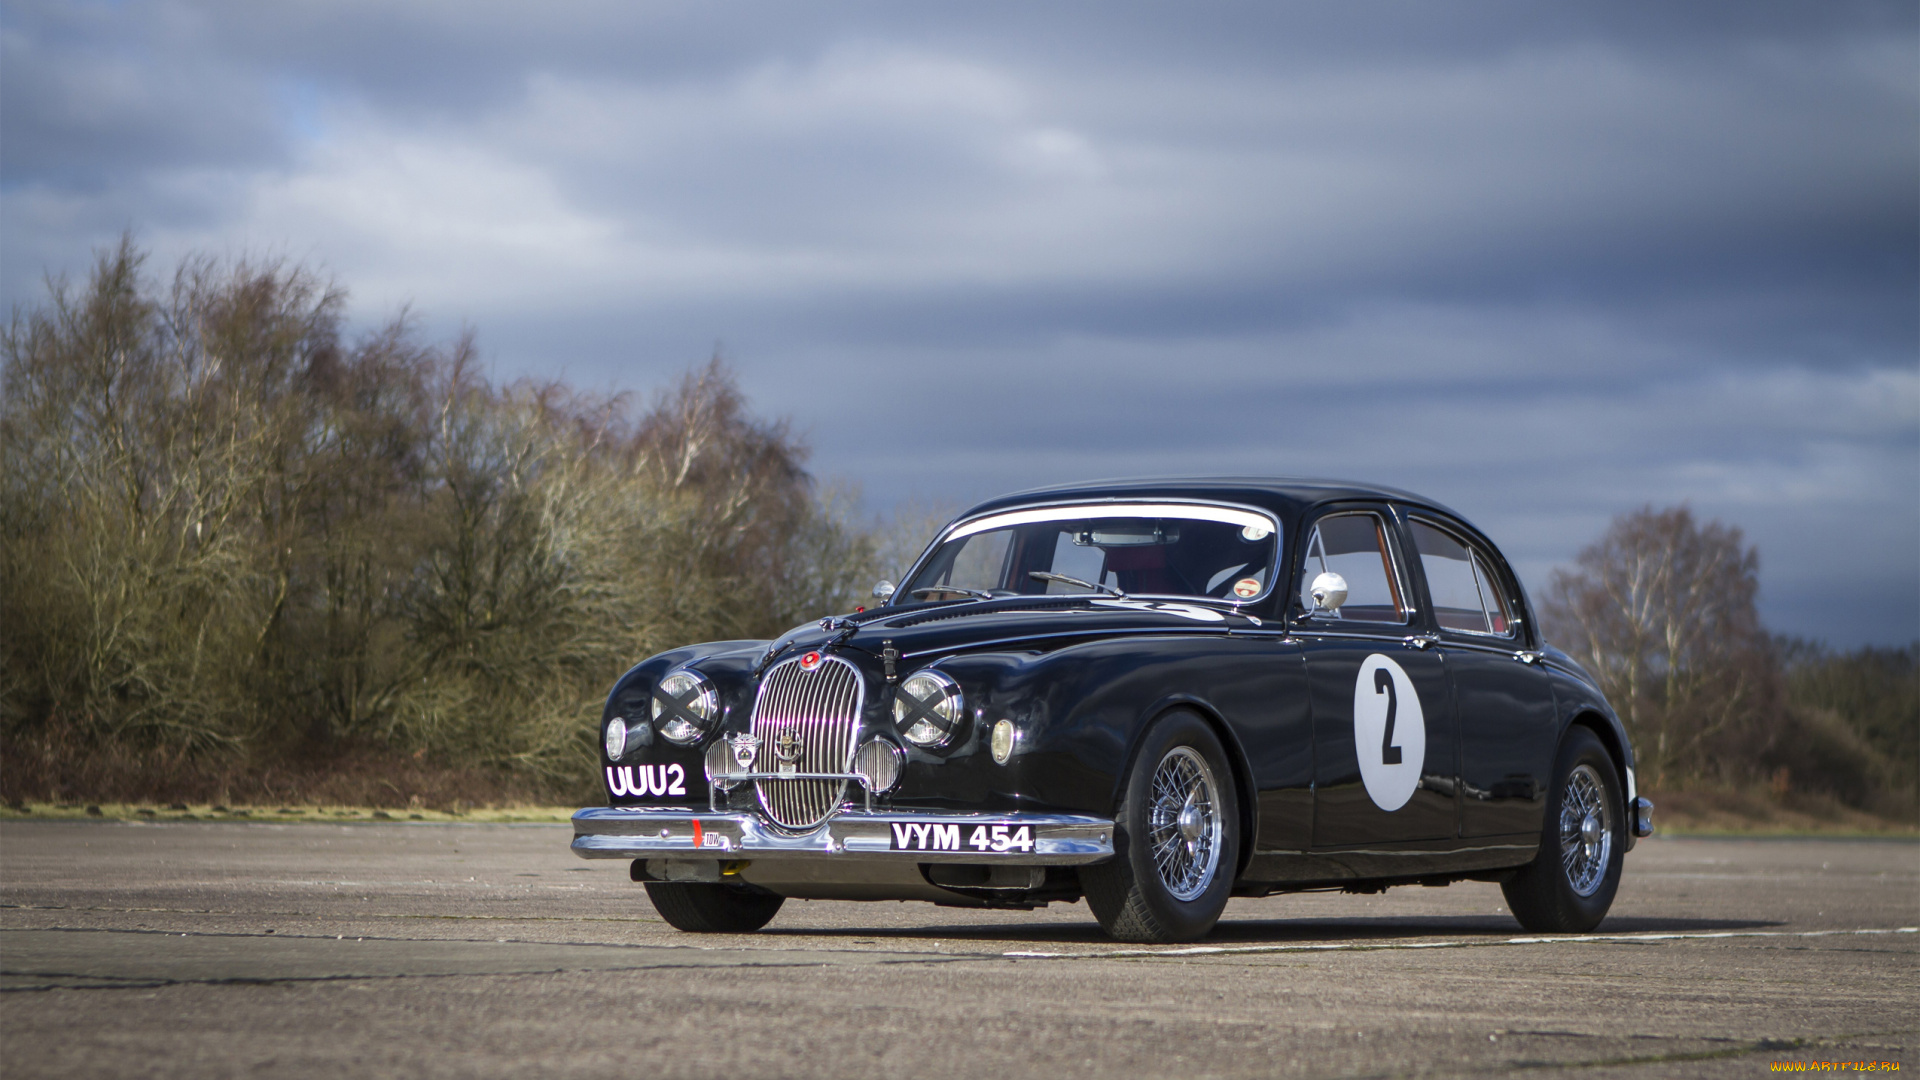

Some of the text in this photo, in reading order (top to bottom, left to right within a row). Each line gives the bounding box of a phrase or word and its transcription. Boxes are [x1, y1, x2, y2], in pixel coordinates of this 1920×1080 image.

[1374, 668, 1402, 765] 2
[606, 763, 686, 797] UUU2
[706, 833, 719, 845] TOW
[892, 823, 1033, 852] VYM 454
